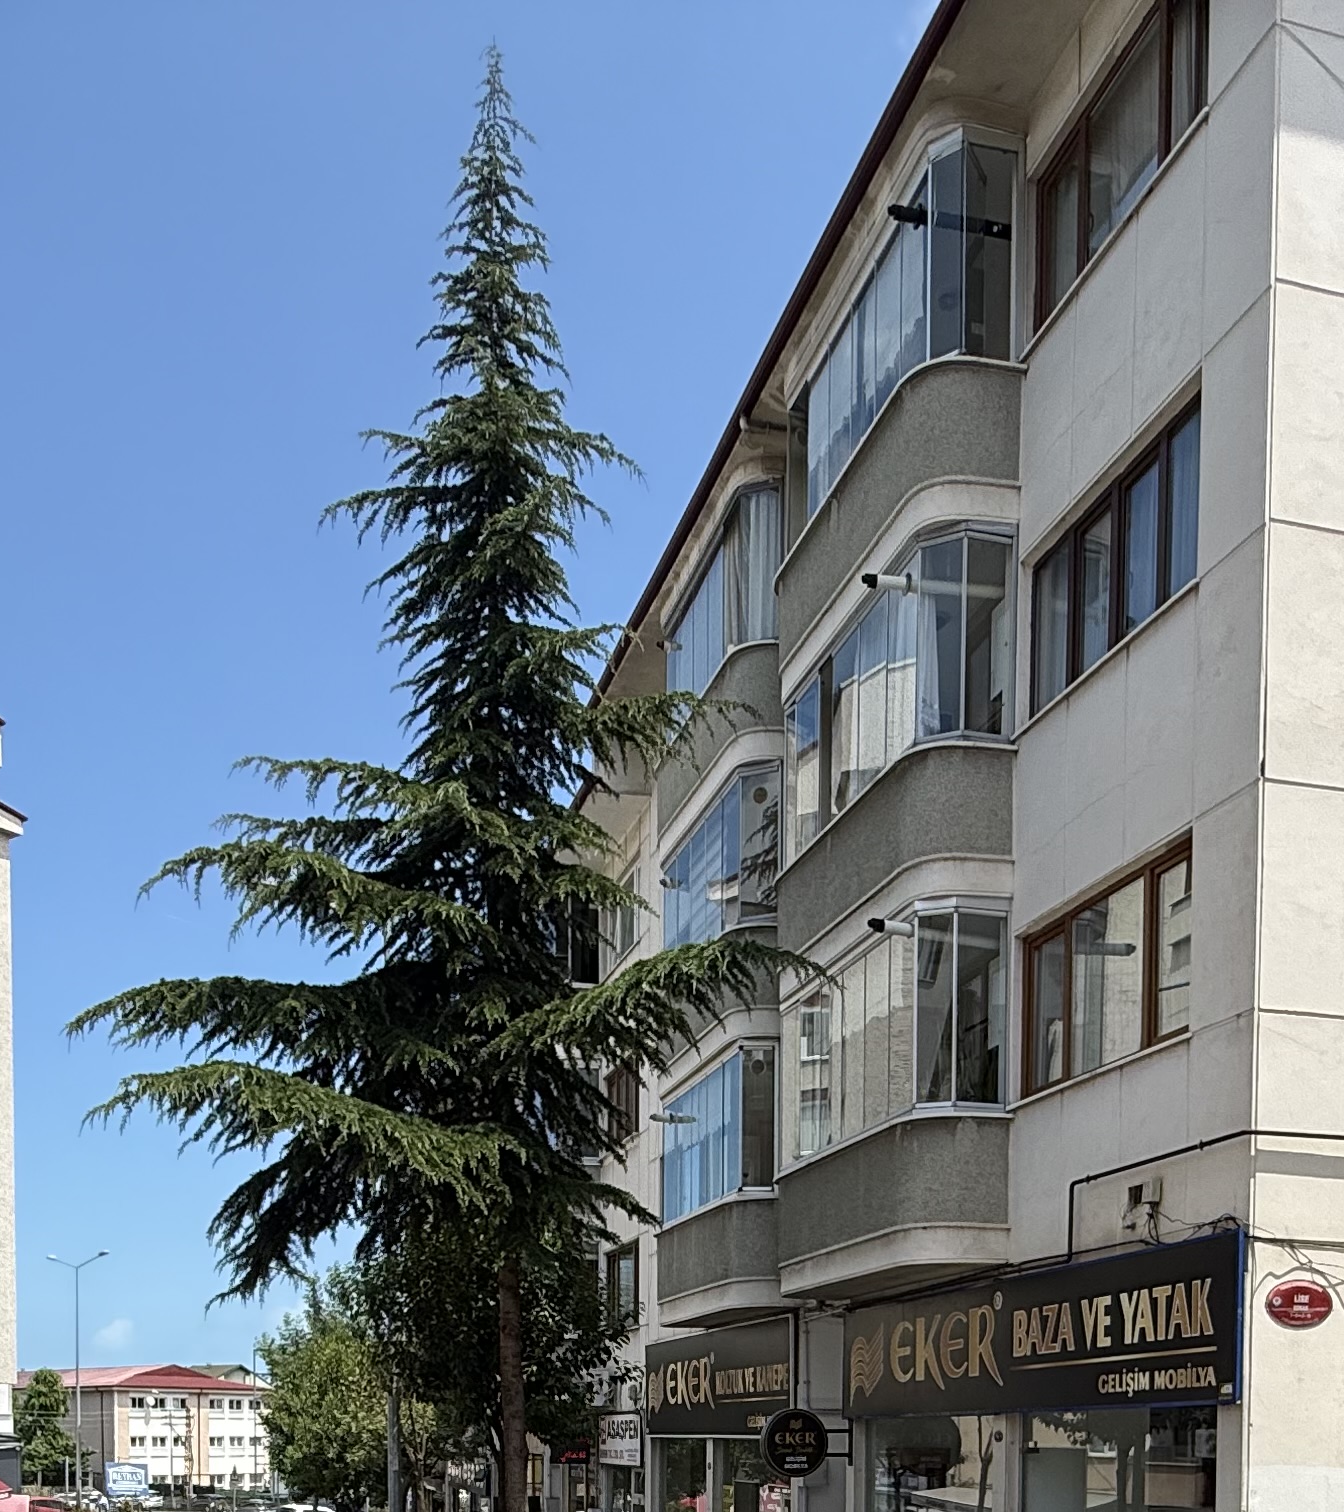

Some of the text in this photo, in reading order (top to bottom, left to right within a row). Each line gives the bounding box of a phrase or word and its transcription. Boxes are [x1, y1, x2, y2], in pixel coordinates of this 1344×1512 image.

[1012, 1302, 1076, 1358] BAZA
[1081, 1295, 1112, 1351] VE
[1119, 1277, 1215, 1345] YATAK
[744, 1367, 755, 1393] VE
[1098, 1362, 1217, 1397] GELİŞİM MOBİLYA
[775, 1432, 816, 1446] EKER
